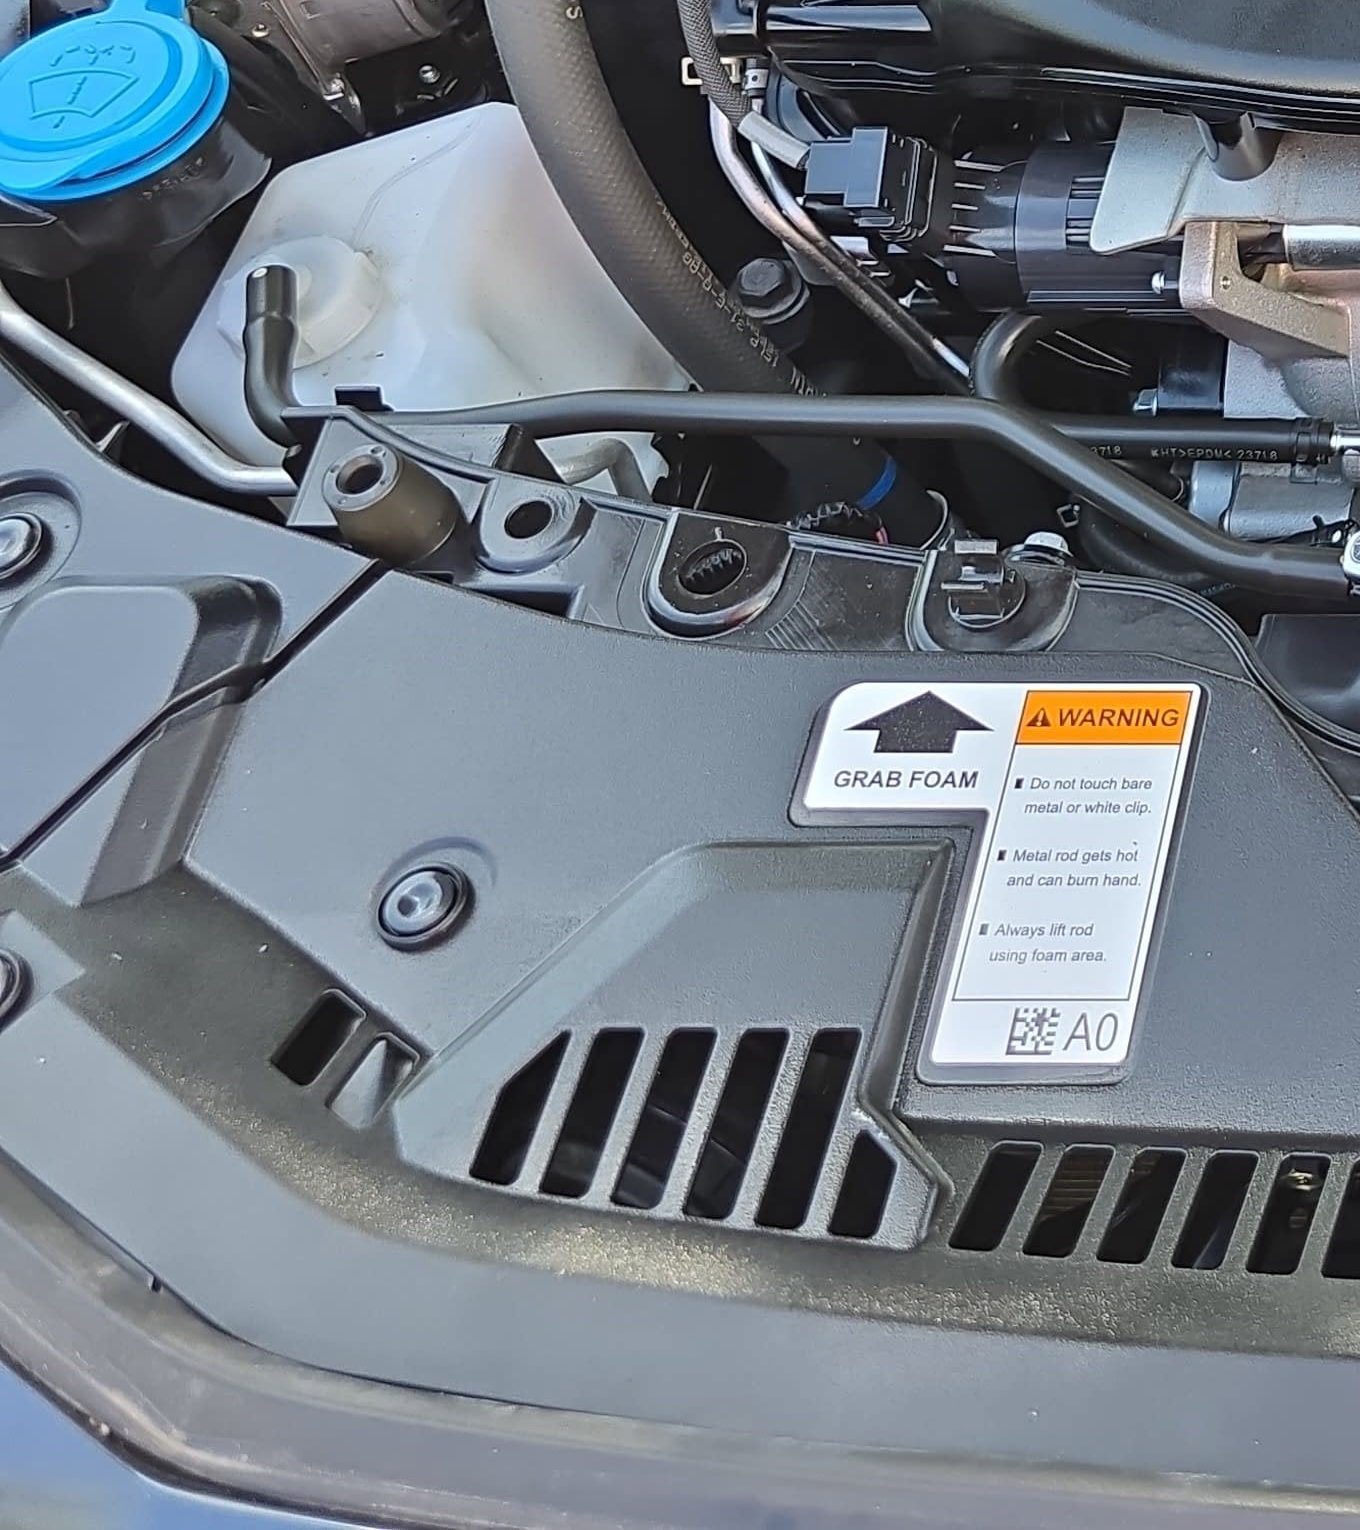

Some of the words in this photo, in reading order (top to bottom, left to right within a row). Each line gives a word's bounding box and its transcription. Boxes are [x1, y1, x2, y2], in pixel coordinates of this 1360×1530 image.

[1058, 708, 1180, 727] WARNING
[833, 770, 902, 788] GRAB
[908, 770, 980, 788] FOAM
[1030, 777, 1050, 790] Do
[1053, 777, 1076, 790] not
[1079, 777, 1117, 790] touch
[1121, 777, 1153, 790] bare
[1024, 801, 1063, 814] metal
[1066, 804, 1082, 814] or
[1085, 801, 1121, 814] white
[1124, 801, 1152, 816] clip.
[1012, 849, 1052, 862] Metal
[1054, 849, 1079, 862] rod
[1081, 850, 1112, 864] gets
[1115, 849, 1138, 862] hot
[1006, 874, 1034, 887] and
[1037, 876, 1063, 887] can
[1066, 874, 1099, 887] burn
[1102, 874, 1142, 887] hand.
[994, 923, 1046, 939] Always
[1049, 923, 1066, 936] lift
[1069, 924, 1094, 936] rod
[989, 950, 1027, 964] using
[1031, 948, 1067, 962] foam
[1071, 951, 1107, 962] area.
[1062, 1012, 1119, 1052] A0
